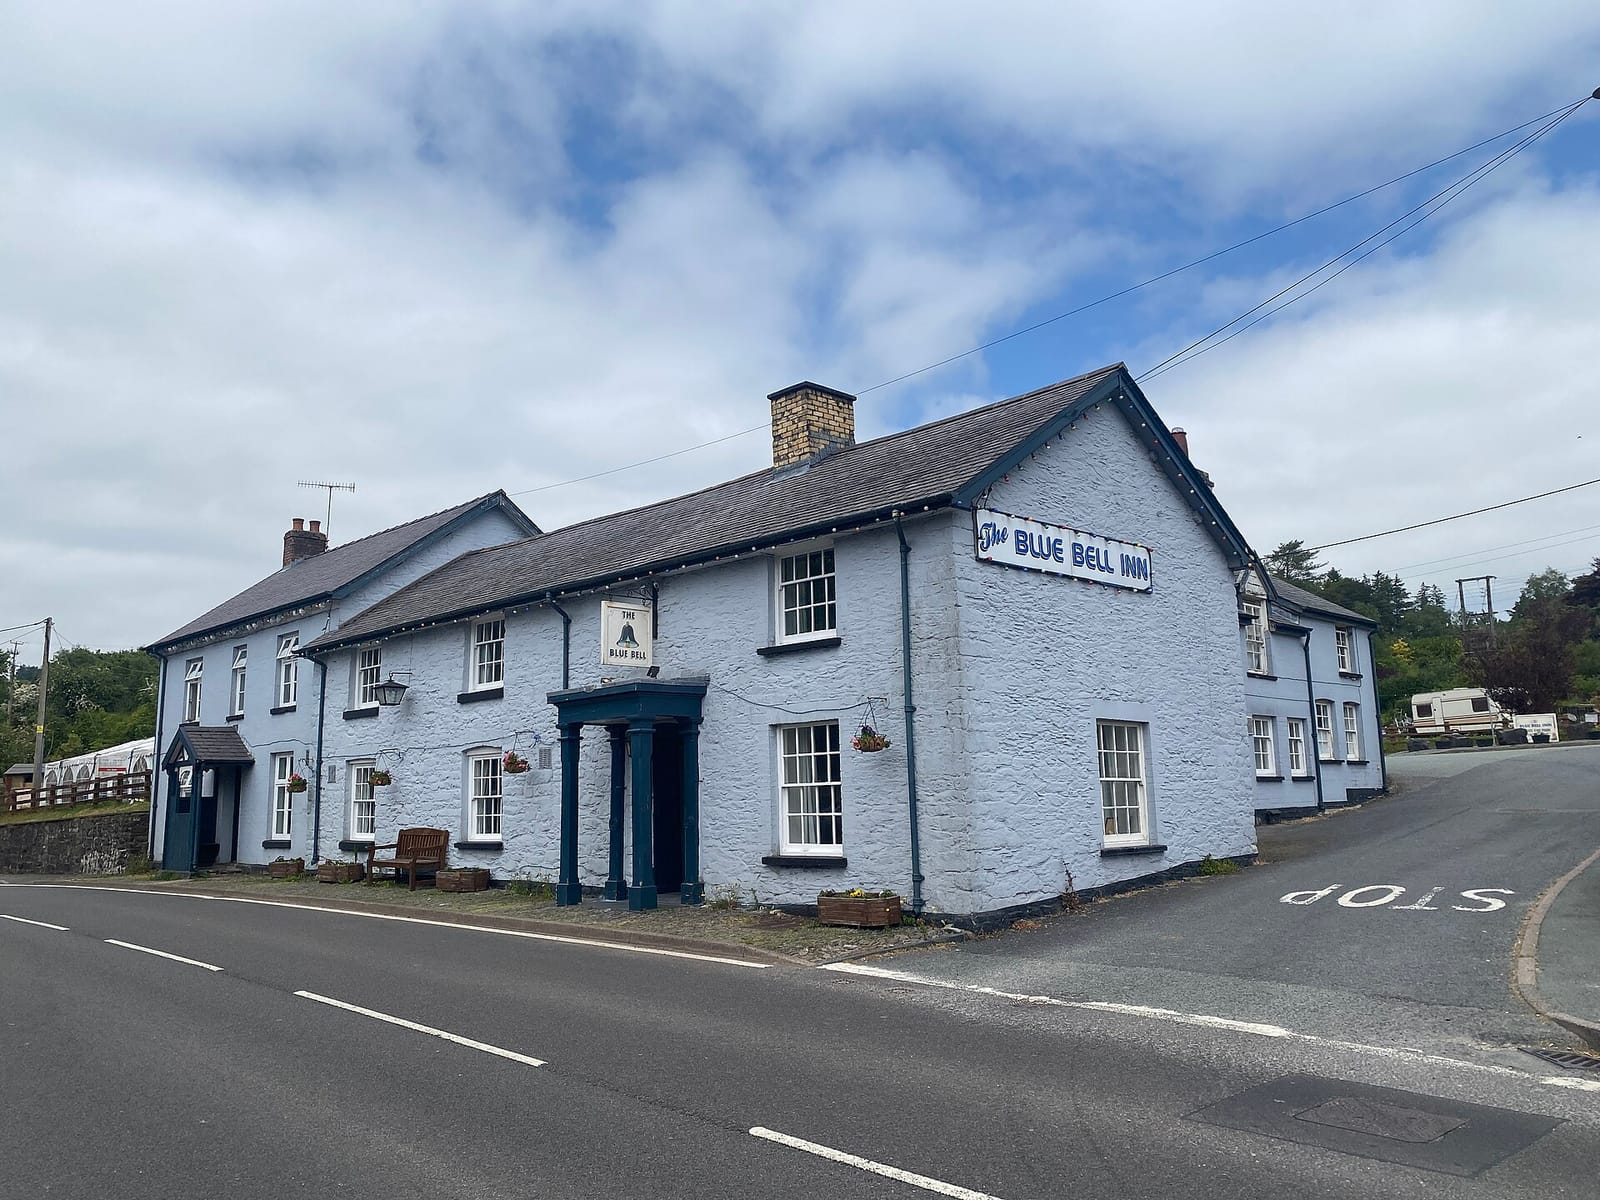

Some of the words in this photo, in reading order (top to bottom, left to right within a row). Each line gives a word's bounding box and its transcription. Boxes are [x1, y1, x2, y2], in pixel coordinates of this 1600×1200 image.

[979, 522, 1009, 552] The
[1014, 529, 1065, 564] BLUE
[1072, 542, 1115, 574] BELL
[1120, 552, 1149, 581] INN
[622, 611, 635, 620] THE
[609, 648, 628, 658] BLUE
[631, 650, 647, 660] BELL
[1279, 883, 1516, 912] STOP
